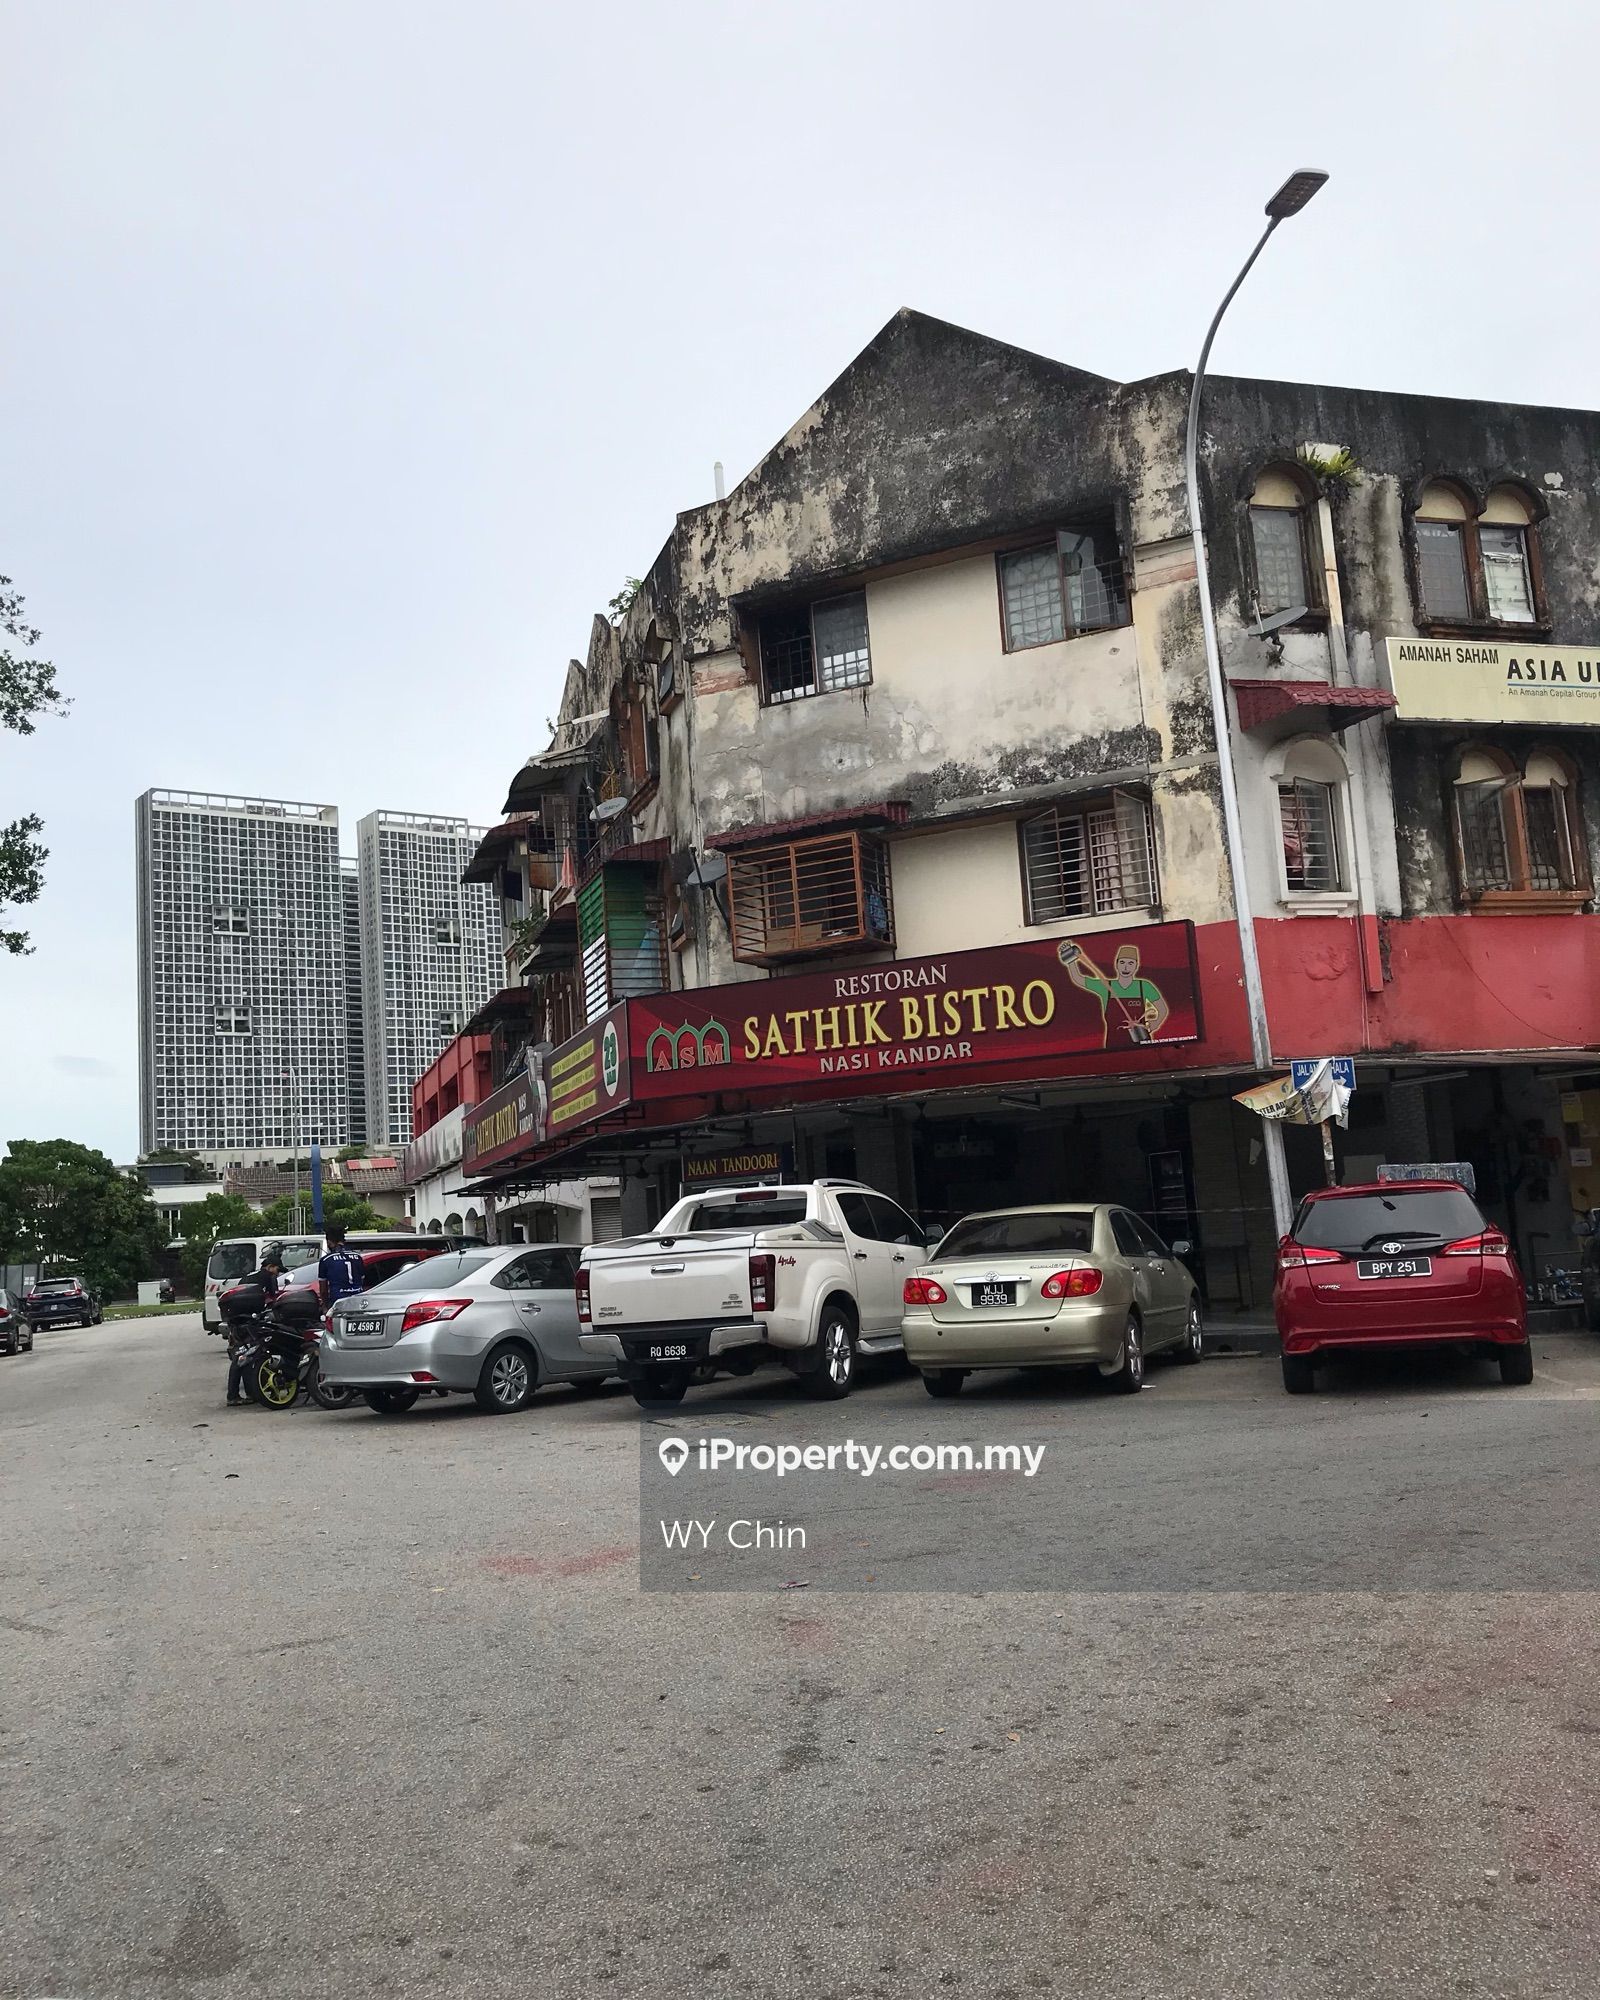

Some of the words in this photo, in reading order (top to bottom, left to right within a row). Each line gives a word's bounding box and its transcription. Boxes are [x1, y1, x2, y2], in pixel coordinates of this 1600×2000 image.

[1399, 645, 1451, 662] AMANAH
[1456, 647, 1499, 665] SAHAM
[1507, 658, 1567, 681] ASIA
[1508, 687, 1518, 696] An
[1520, 688, 1549, 697] Amanah
[1549, 689, 1574, 698] Capital
[1575, 690, 1598, 699] Group
[834, 964, 947, 998] RESTORAN
[744, 1001, 892, 1059] SATHIK
[899, 979, 1055, 1040] BISTRO
[654, 1043, 724, 1072] ASM
[820, 1053, 869, 1073] NASI
[878, 1041, 973, 1067] KANDAR
[496, 1101, 518, 1146] BISTRO
[688, 1160, 717, 1176] NAAN
[722, 1153, 778, 1173] TANDOORI
[1372, 1262, 1393, 1274] BPY
[1397, 1261, 1417, 1273] 251
[980, 1294, 1008, 1305] 9939
[983, 1284, 1004, 1294] WJJ
[357, 1322, 373, 1332] 4596
[375, 1321, 380, 1331] R
[650, 1346, 662, 1357] RQ
[664, 1345, 687, 1356] 6638
